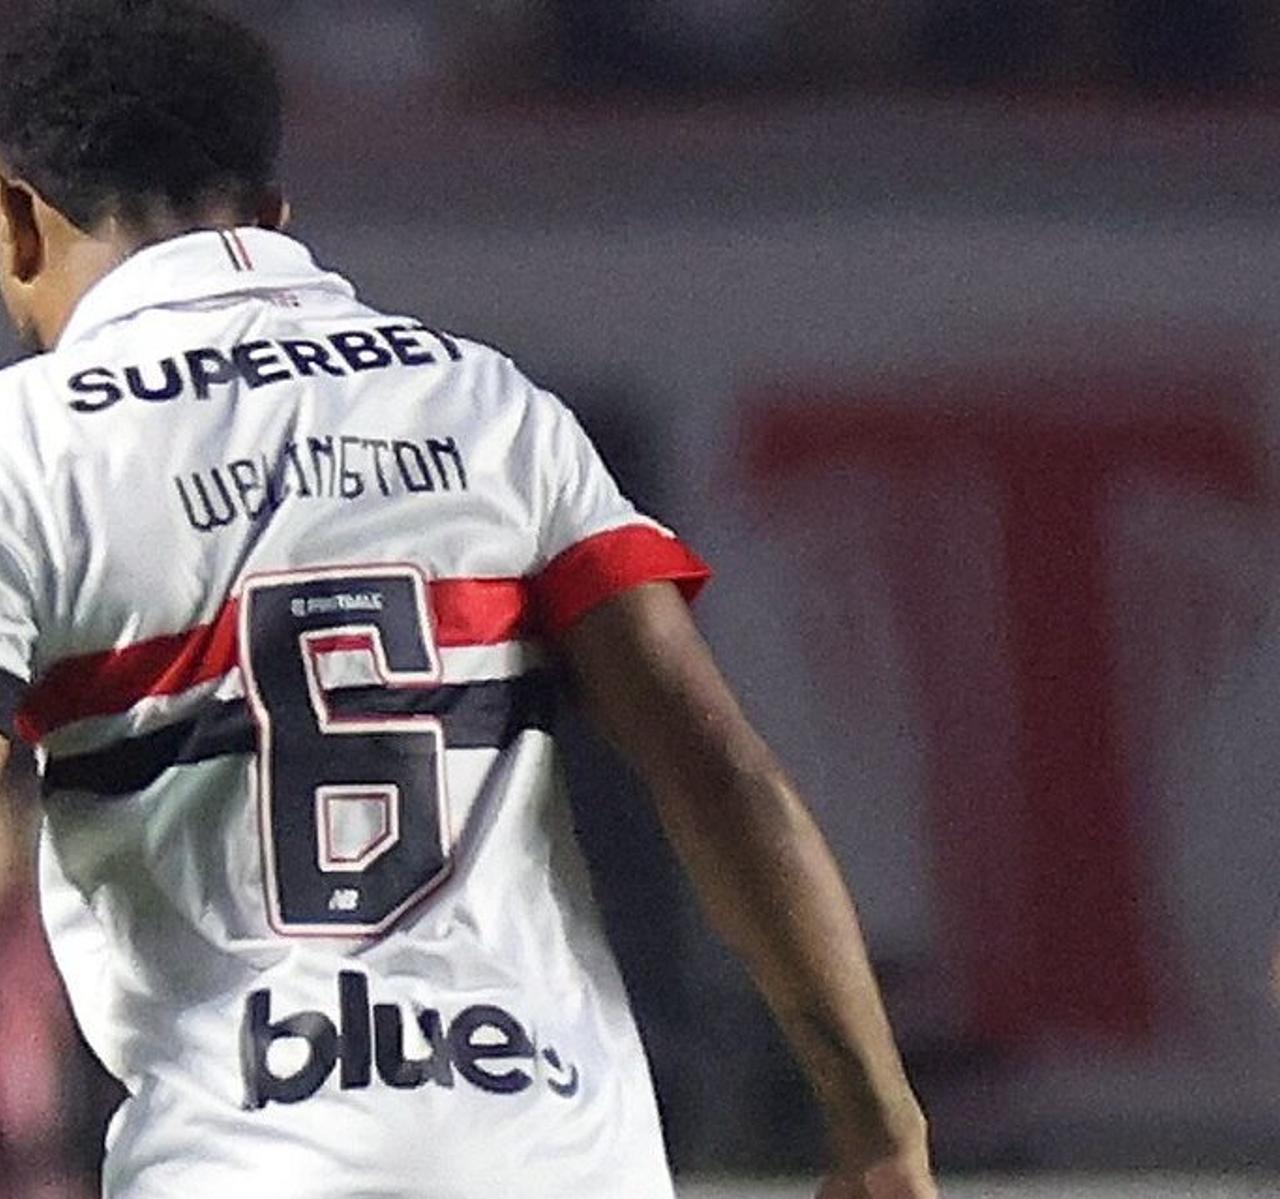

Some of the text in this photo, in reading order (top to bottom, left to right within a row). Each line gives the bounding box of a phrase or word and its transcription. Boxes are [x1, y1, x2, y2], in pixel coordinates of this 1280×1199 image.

[68, 325, 462, 413] SUPERBET
[239, 564, 454, 937] 6
[242, 969, 534, 1111] blue
